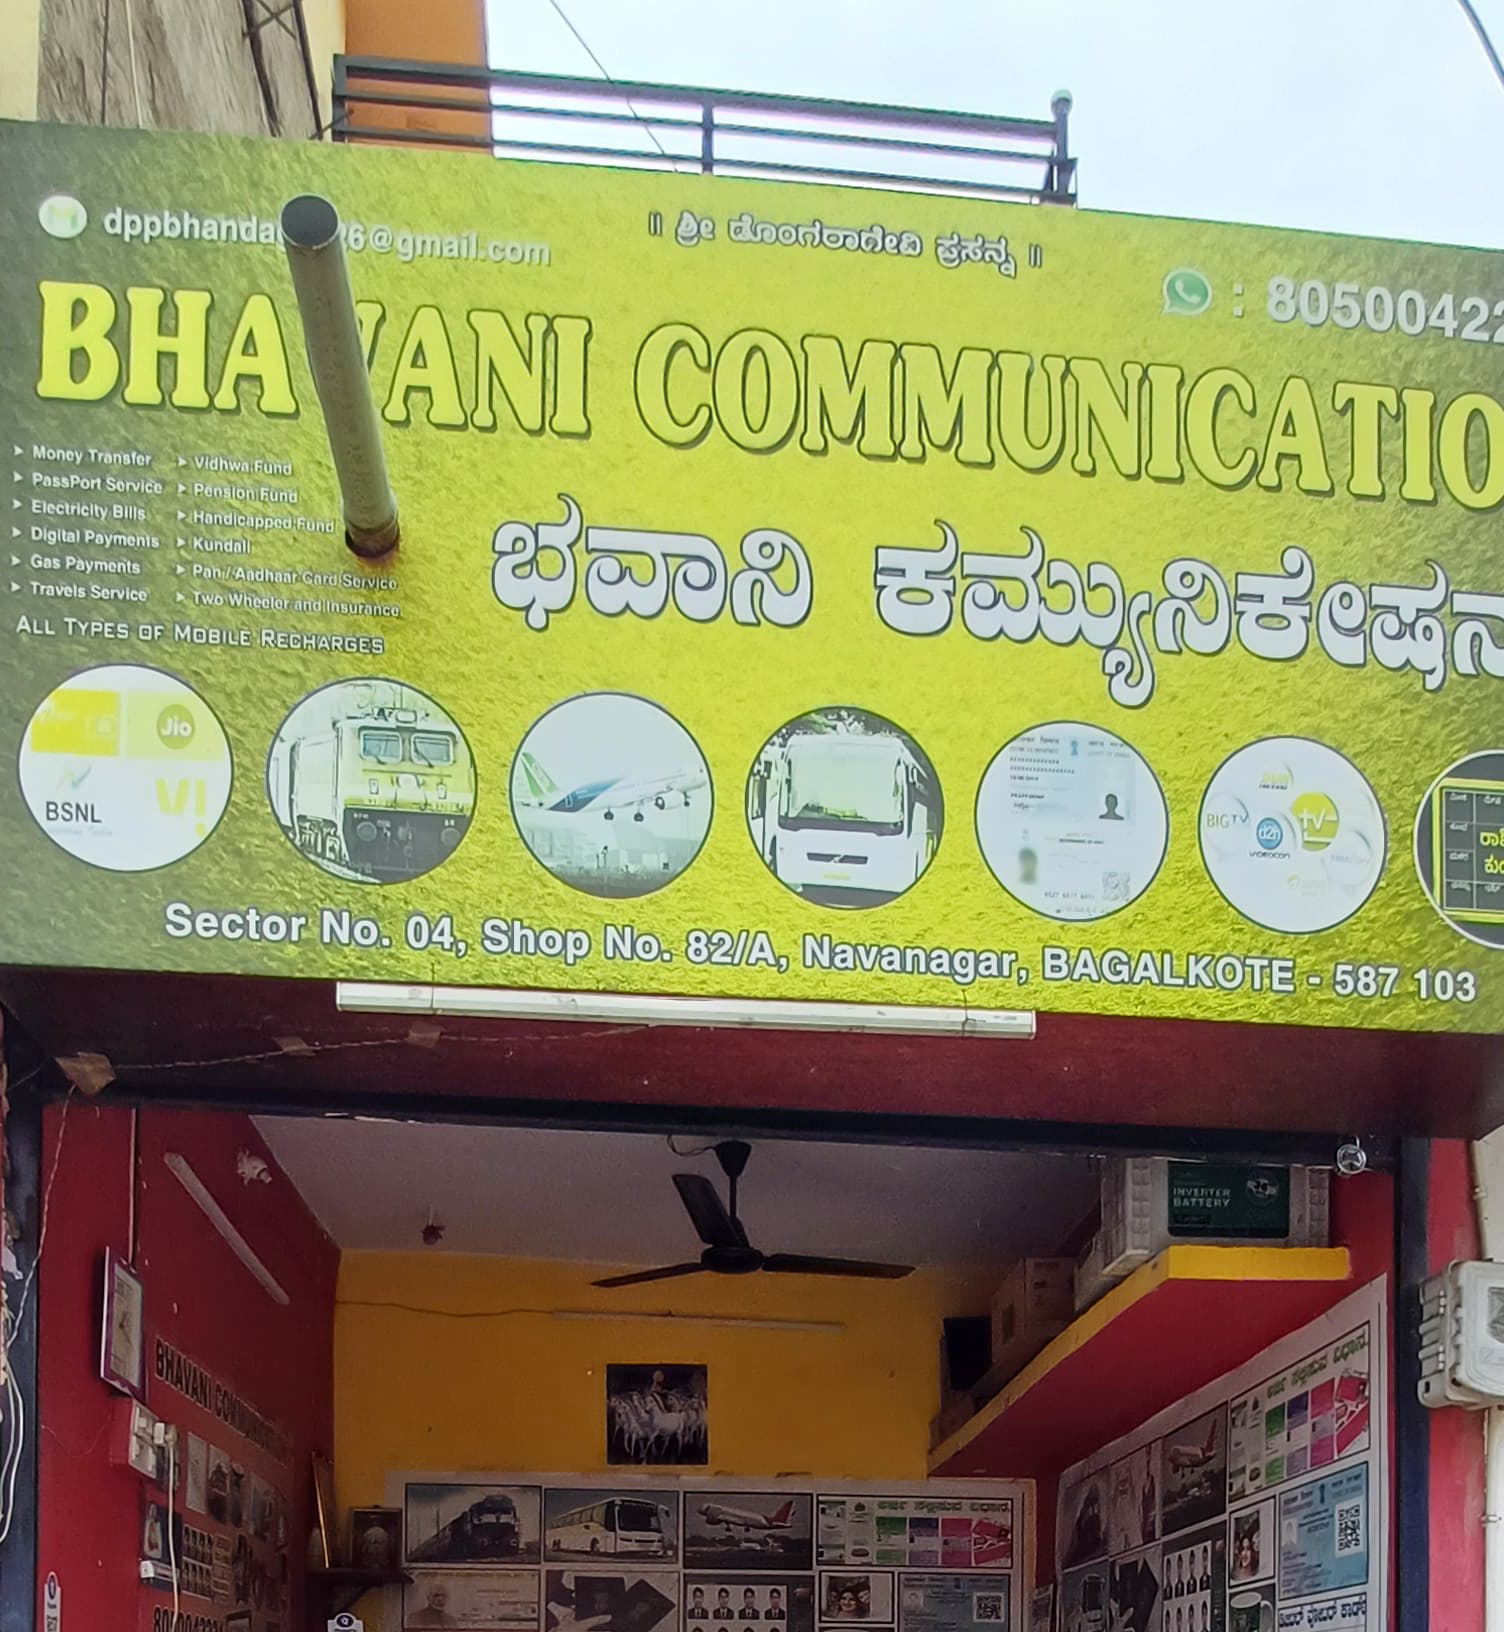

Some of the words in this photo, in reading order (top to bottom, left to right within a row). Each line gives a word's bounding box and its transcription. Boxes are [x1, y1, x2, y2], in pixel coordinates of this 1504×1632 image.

[936, 233, 1016, 279] ಪ್ರಸನ್ನ
[33, 445, 83, 465] Money
[90, 448, 153, 467] Transfer
[255, 459, 292, 476] Fund
[33, 471, 101, 491] PassPort
[106, 476, 163, 495] Service
[194, 483, 254, 501] Pension
[260, 487, 298, 504] Fund
[32, 499, 109, 521] Electricity
[113, 504, 147, 521] Bills
[194, 510, 290, 532] Handicapped
[297, 516, 335, 533] Fund
[31, 526, 80, 546] Digital
[85, 529, 161, 549] Payments
[193, 537, 250, 554] Kundali
[31, 554, 61, 571] Gas
[66, 557, 141, 576] Payments
[492, 492, 813, 632] ಭವಾನಿ
[193, 564, 222, 580] Pan
[302, 571, 338, 588] Card
[341, 573, 398, 591] Service
[31, 582, 86, 599] Travels
[90, 585, 148, 603] Service
[193, 590, 223, 607] Two
[228, 593, 289, 611] Wheeler
[294, 596, 321, 612] and
[326, 599, 401, 617] Insurance
[16, 615, 55, 636] ALL
[64, 617, 129, 639] TYPES
[139, 624, 164, 641] OF
[175, 624, 251, 646] MOBILE
[261, 630, 385, 655] RECHARGES
[45, 800, 102, 824] BSNL
[1207, 813, 1229, 829] BIG
[1231, 812, 1249, 824] TV
[164, 901, 307, 941] Sector
[320, 910, 391, 948] No.
[406, 914, 466, 956] 04,
[481, 916, 590, 964] Shop
[603, 923, 671, 959] No.
[685, 928, 789, 972] 82/A,
[802, 934, 1031, 987] Navanagar,
[1041, 946, 1296, 994] BAGALKOTE
[1331, 965, 1397, 1000] 587
[1413, 967, 1476, 1002] 103
[1173, 1187, 1231, 1198] INVERTER
[1173, 1198, 1231, 1208] BATTERY
[156, 1338, 212, 1412] BHAVANI
